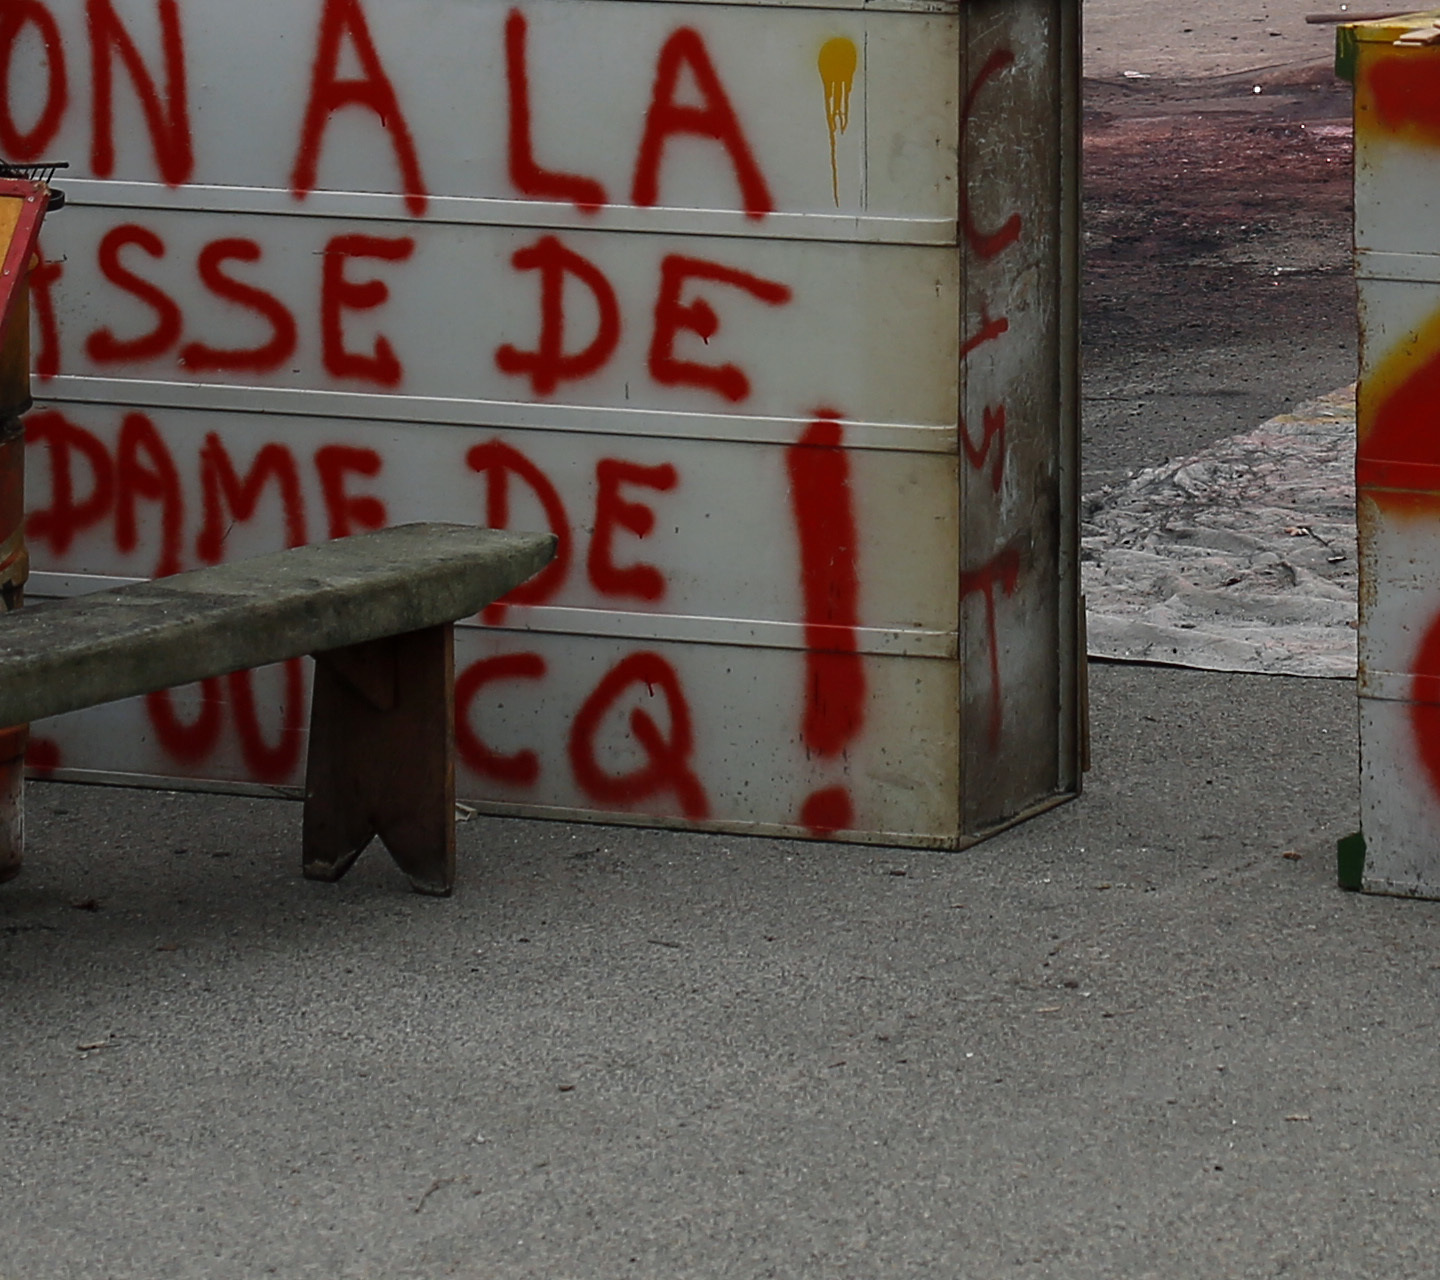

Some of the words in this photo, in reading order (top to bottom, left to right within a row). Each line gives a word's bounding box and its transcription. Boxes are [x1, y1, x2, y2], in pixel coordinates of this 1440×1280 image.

[506, 8, 774, 222] LA
[495, 233, 794, 404] DE
[465, 439, 681, 624] DE
